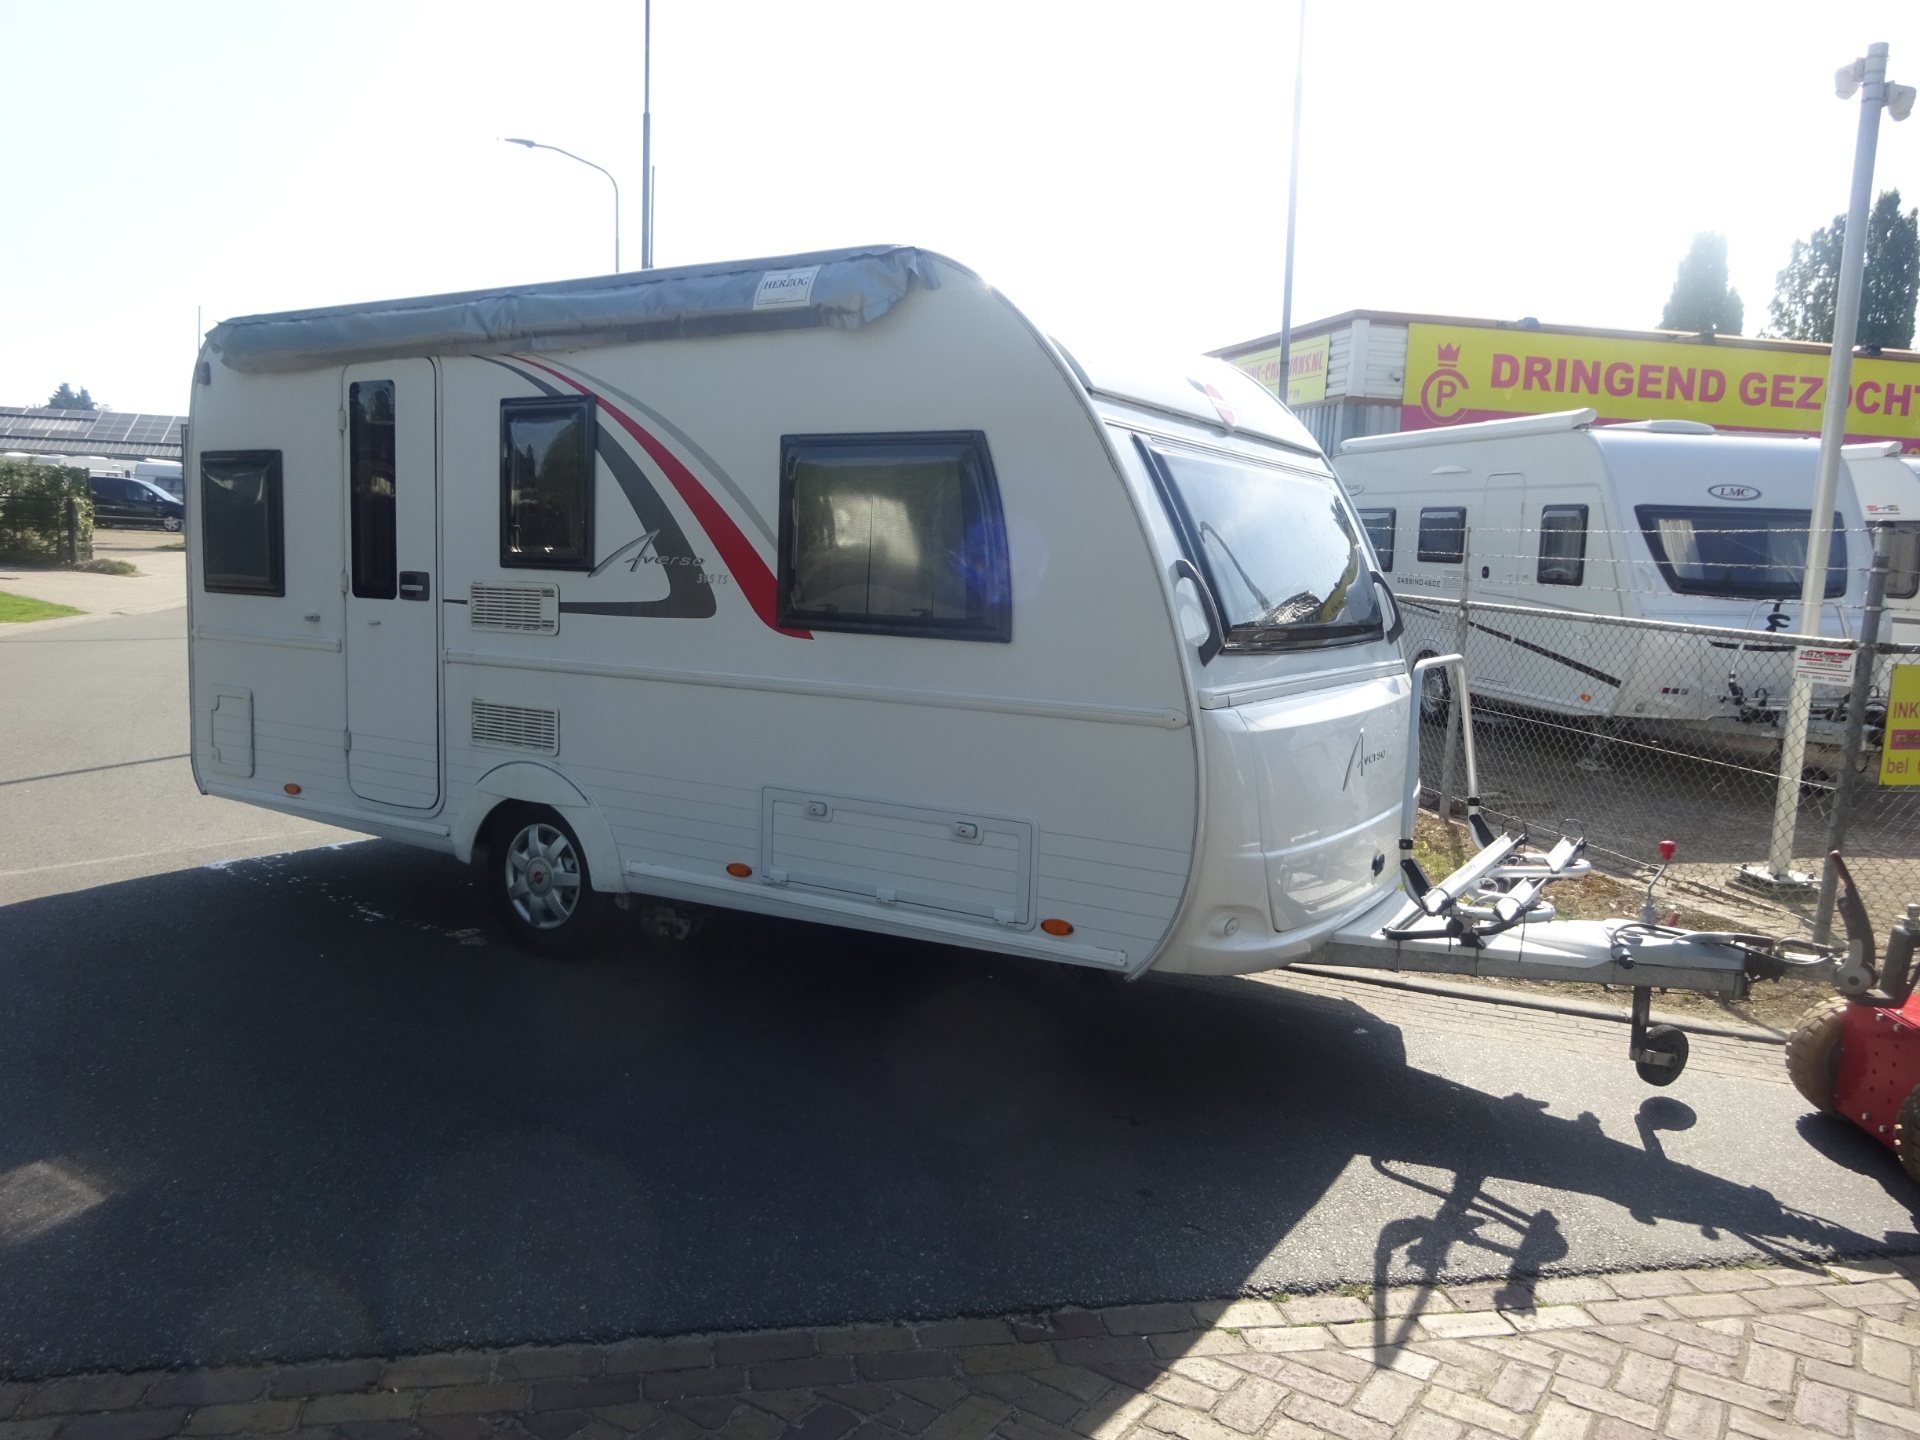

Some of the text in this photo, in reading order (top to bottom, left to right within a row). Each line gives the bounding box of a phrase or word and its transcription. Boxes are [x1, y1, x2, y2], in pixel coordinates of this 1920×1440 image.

[764, 277, 809, 289] HERZOG
[1490, 353, 1920, 417] DRINGEND GEZCH
[1720, 487, 1750, 497] LMC
[588, 529, 705, 577] Averso
[697, 573, 728, 584] 395 TS
[1886, 757, 1909, 774] bel
